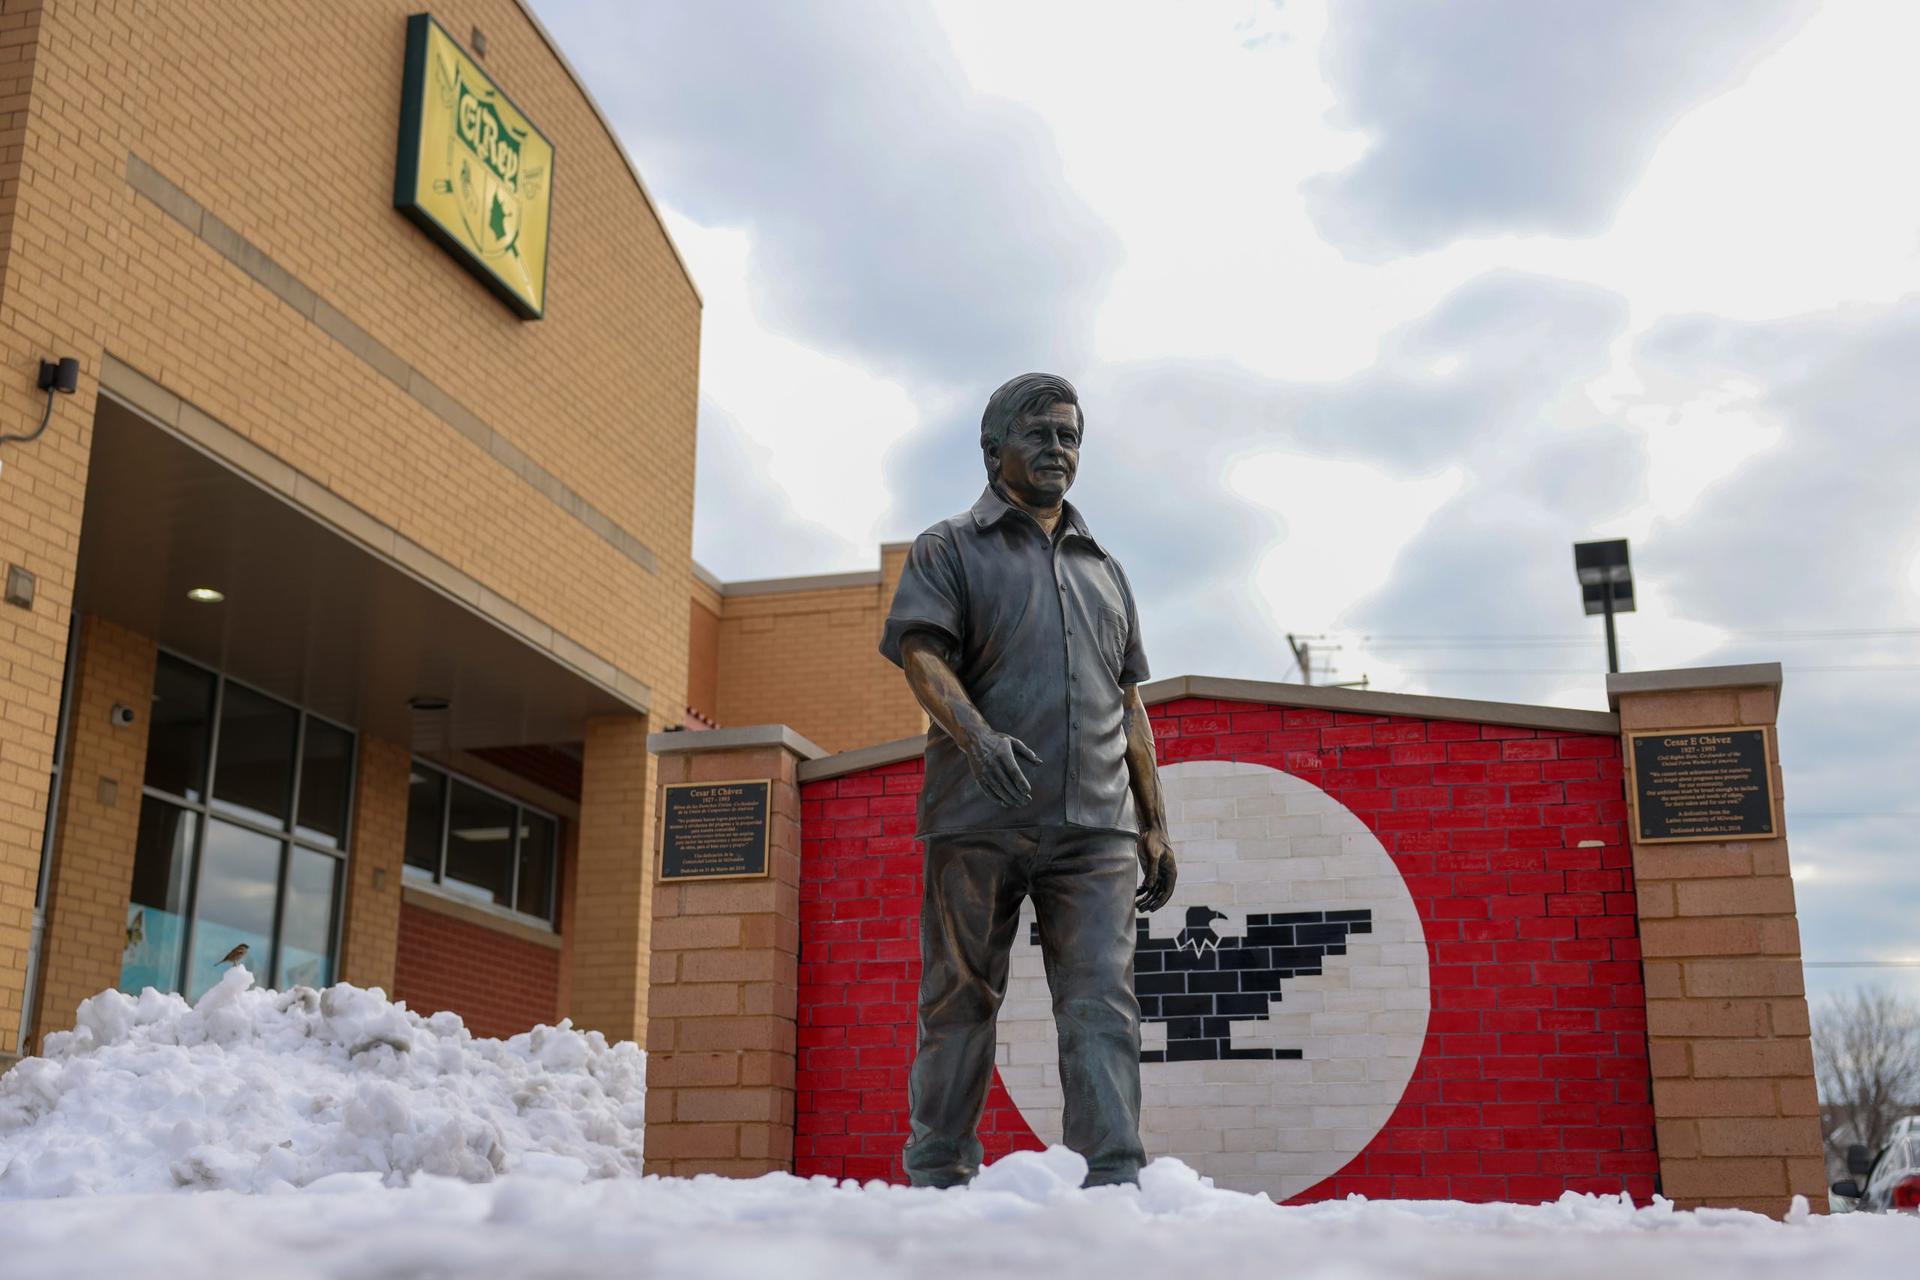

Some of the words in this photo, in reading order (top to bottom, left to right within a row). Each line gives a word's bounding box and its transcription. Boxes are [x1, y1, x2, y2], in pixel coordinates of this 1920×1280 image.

[477, 107, 517, 190] Rey
[1664, 738, 1688, 747] Cesar
[1690, 737, 1698, 746] E
